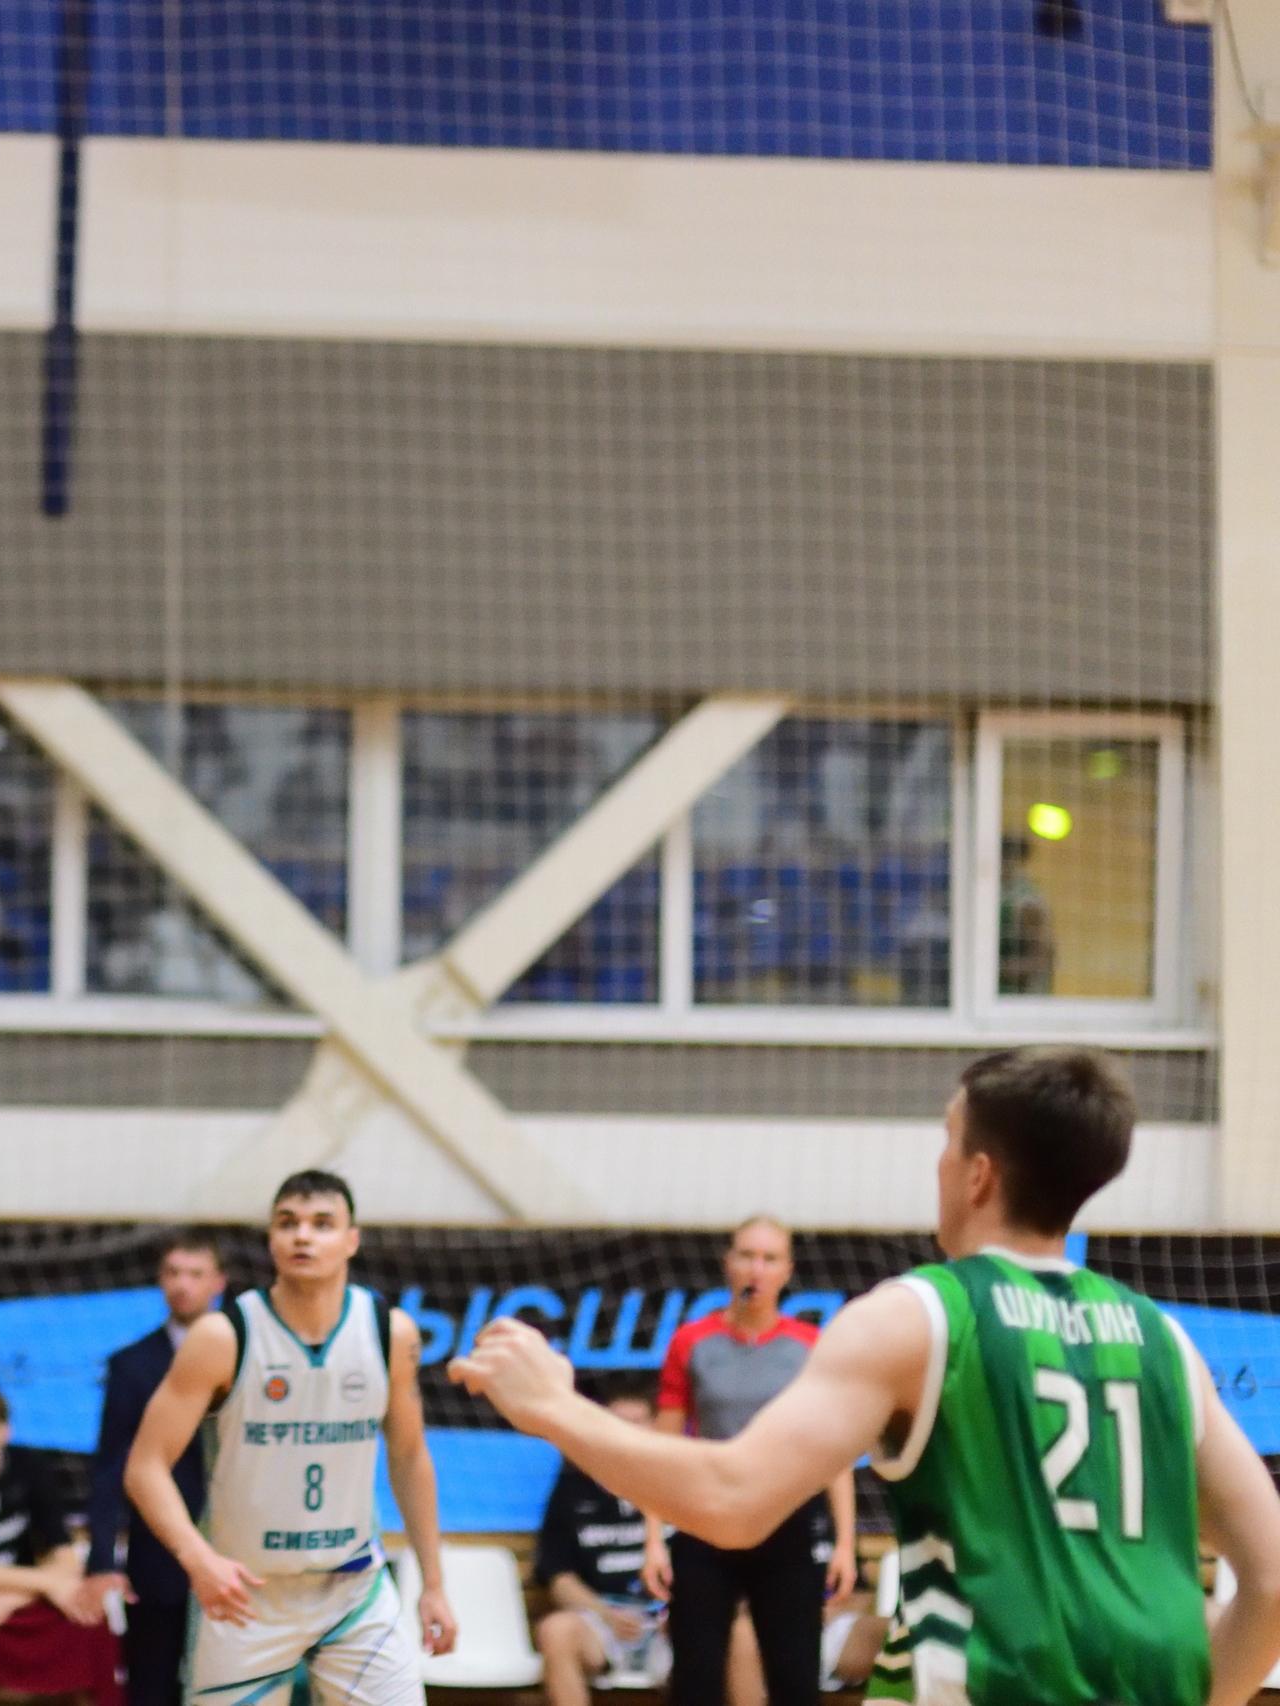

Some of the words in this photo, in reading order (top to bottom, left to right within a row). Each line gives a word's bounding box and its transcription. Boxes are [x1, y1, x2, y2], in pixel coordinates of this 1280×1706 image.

[1034, 1366, 1144, 1540] 21
[303, 1462, 325, 1513] 8
[263, 1526, 357, 1551] СИБУР
